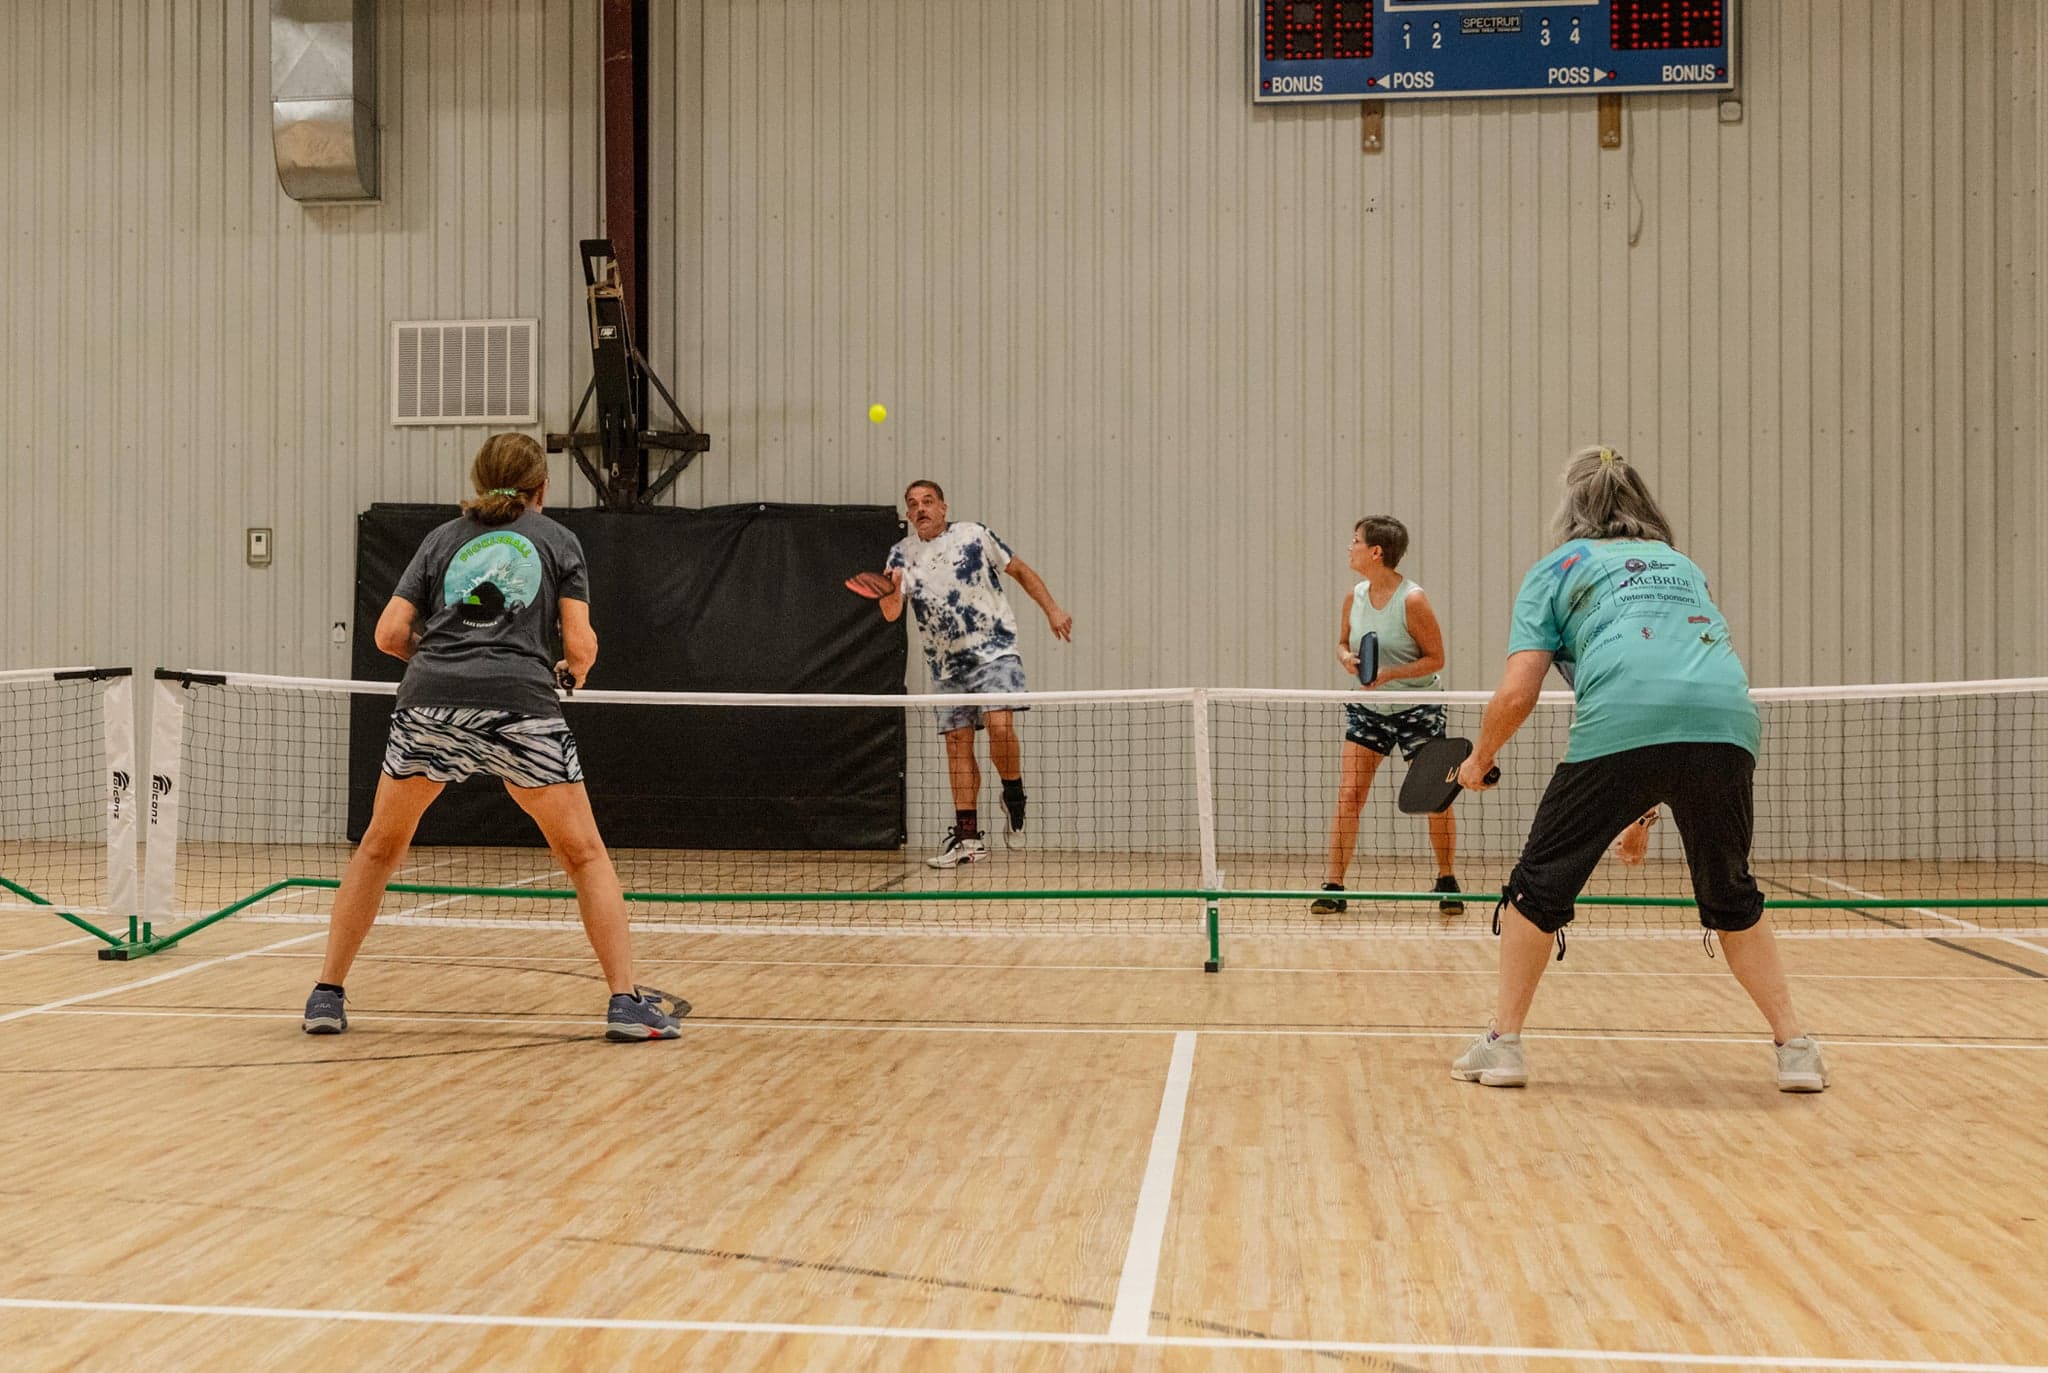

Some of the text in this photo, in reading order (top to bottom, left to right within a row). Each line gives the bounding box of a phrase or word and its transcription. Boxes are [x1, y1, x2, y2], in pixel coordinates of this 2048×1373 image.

[1463, 16, 1520, 28] SPECTRUM
[1403, 32, 1442, 49] 1 2
[1540, 28, 1581, 46] 3 4
[1393, 71, 1435, 88] POSS
[1548, 67, 1590, 84] POSS
[1662, 64, 1716, 81] BONUS
[1271, 75, 1324, 93] BONUS
[1620, 593, 1695, 604] Veteran Sponsors
